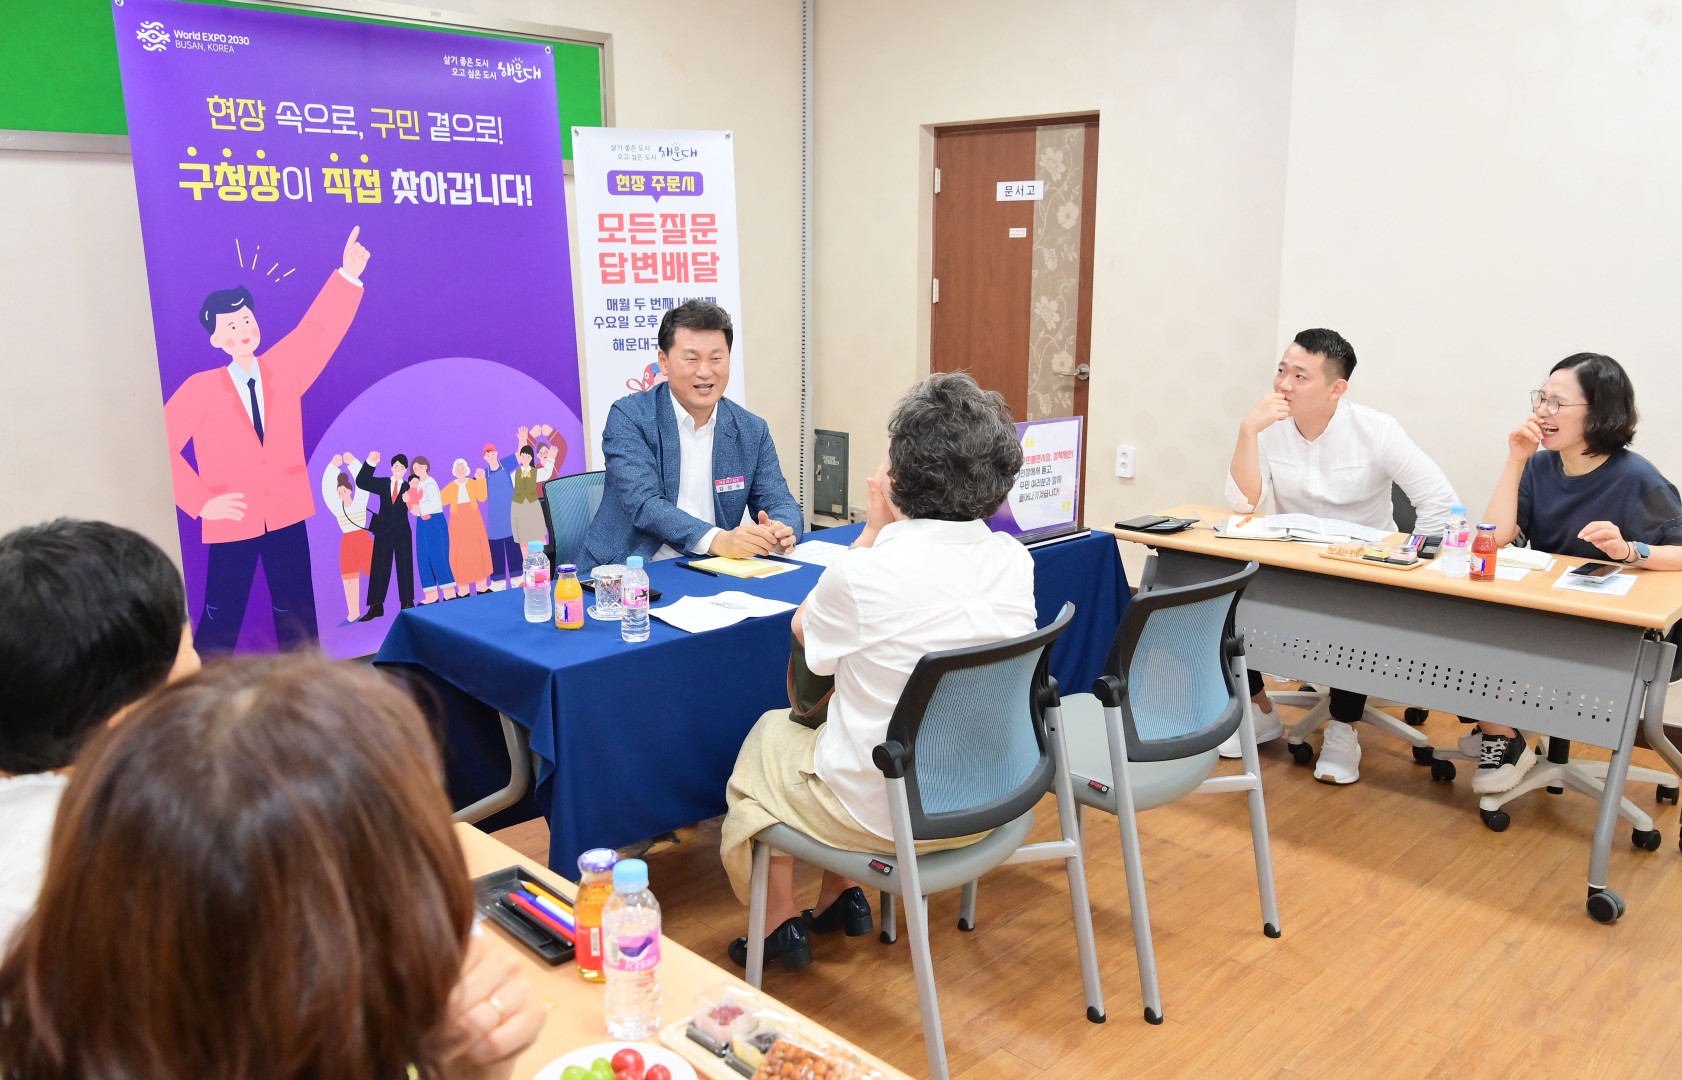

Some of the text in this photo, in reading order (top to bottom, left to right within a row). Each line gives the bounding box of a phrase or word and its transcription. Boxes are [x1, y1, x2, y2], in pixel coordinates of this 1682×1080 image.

[173, 29, 250, 46] World EXPO 2030
[175, 40, 236, 53] BUSAN, KOREA
[443, 54, 489, 68] 살기 좋은 도시
[452, 67, 497, 80] 오고 싶은 도시
[498, 60, 542, 83] 해운대
[207, 95, 504, 145] 현장 속으로, 구민 곁으로!
[610, 144, 623, 152] 살기
[624, 144, 636, 152] 좋은
[658, 146, 698, 162] 해운대
[645, 153, 657, 161] 도시
[179, 160, 532, 206] 구청장이 직접 찾아갑니다!
[616, 174, 695, 193] 현장 주문시
[1004, 185, 1035, 197] 문서고
[597, 212, 719, 245] 모든질문
[599, 252, 720, 284] 답변배달
[606, 298, 630, 311] 매월
[635, 298, 647, 311] 두
[650, 297, 674, 311] 번째
[593, 314, 659, 329] 수요일 오후
